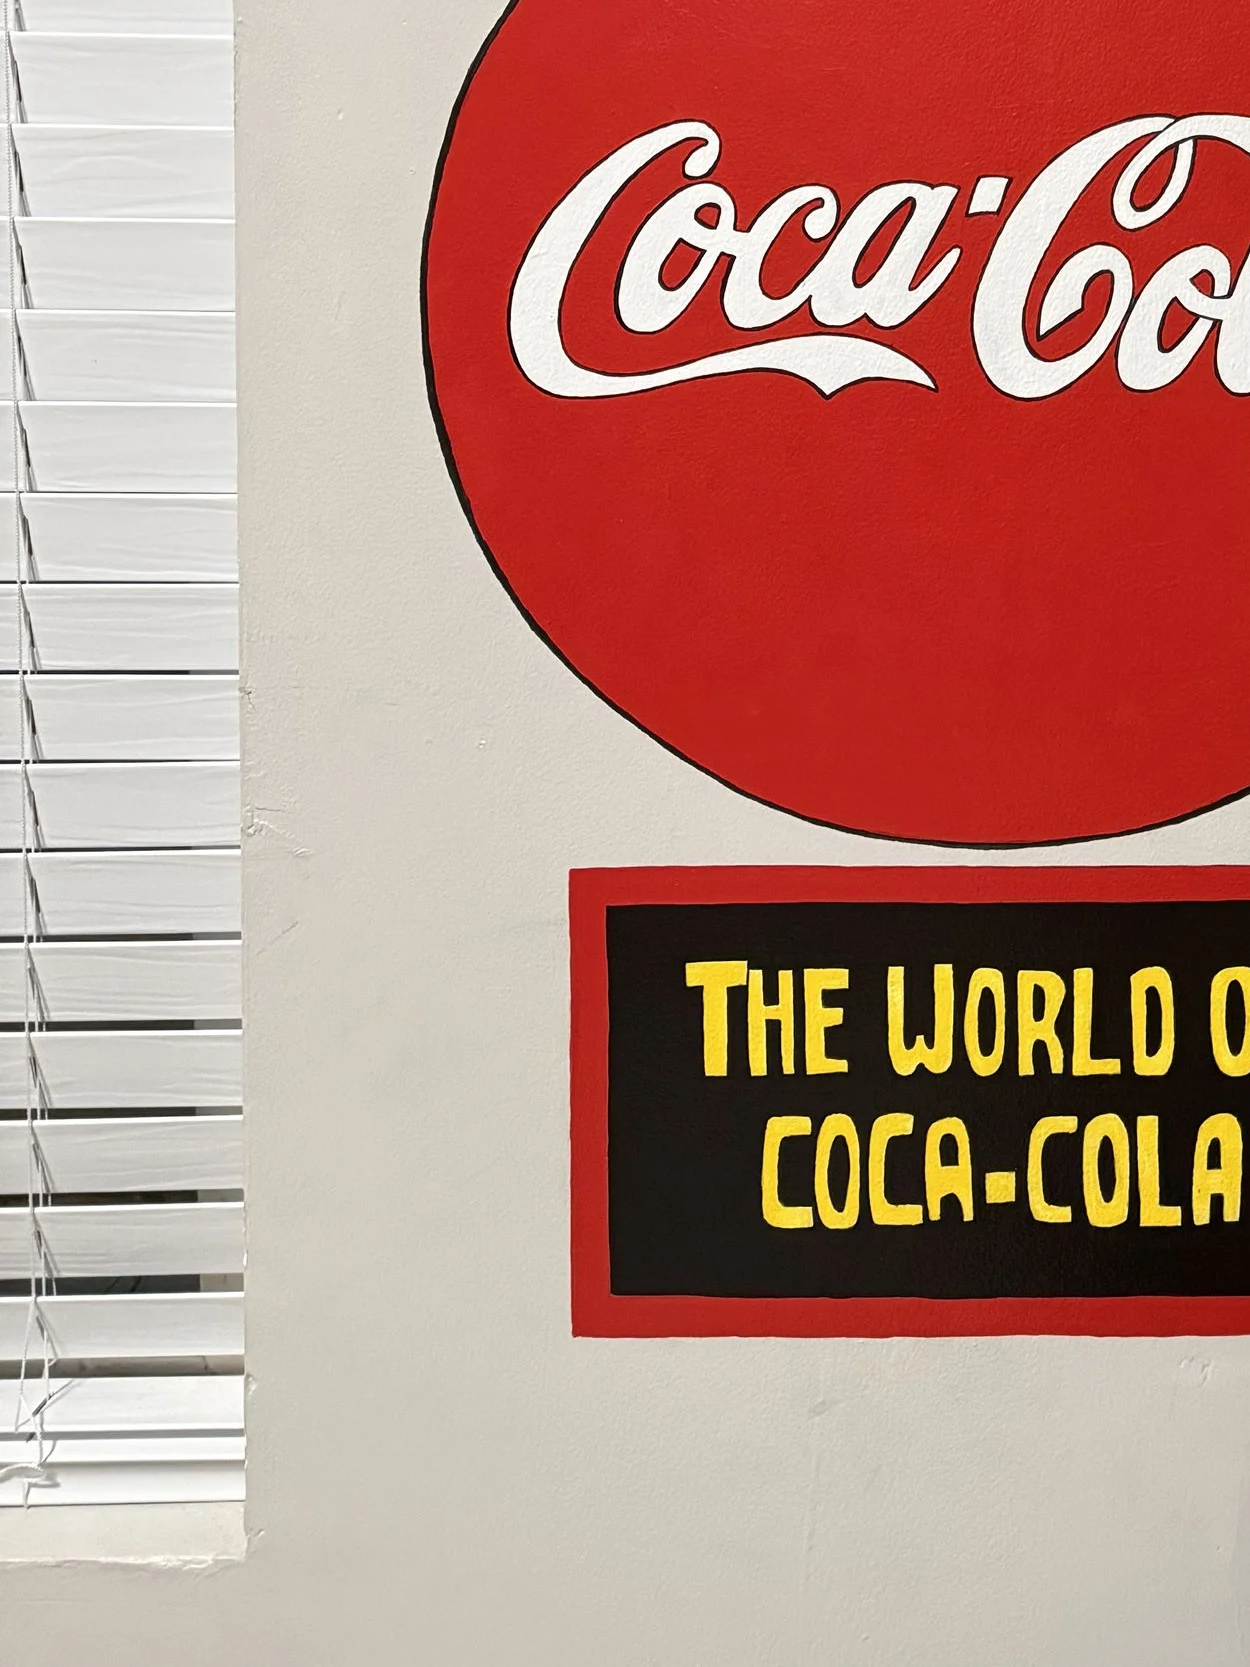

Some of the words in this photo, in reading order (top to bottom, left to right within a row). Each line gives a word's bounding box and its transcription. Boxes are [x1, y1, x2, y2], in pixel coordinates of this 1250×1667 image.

[685, 959, 850, 1078] THE
[886, 962, 1176, 1078] WORLD
[761, 1111, 1244, 1231] COCA-COLA
